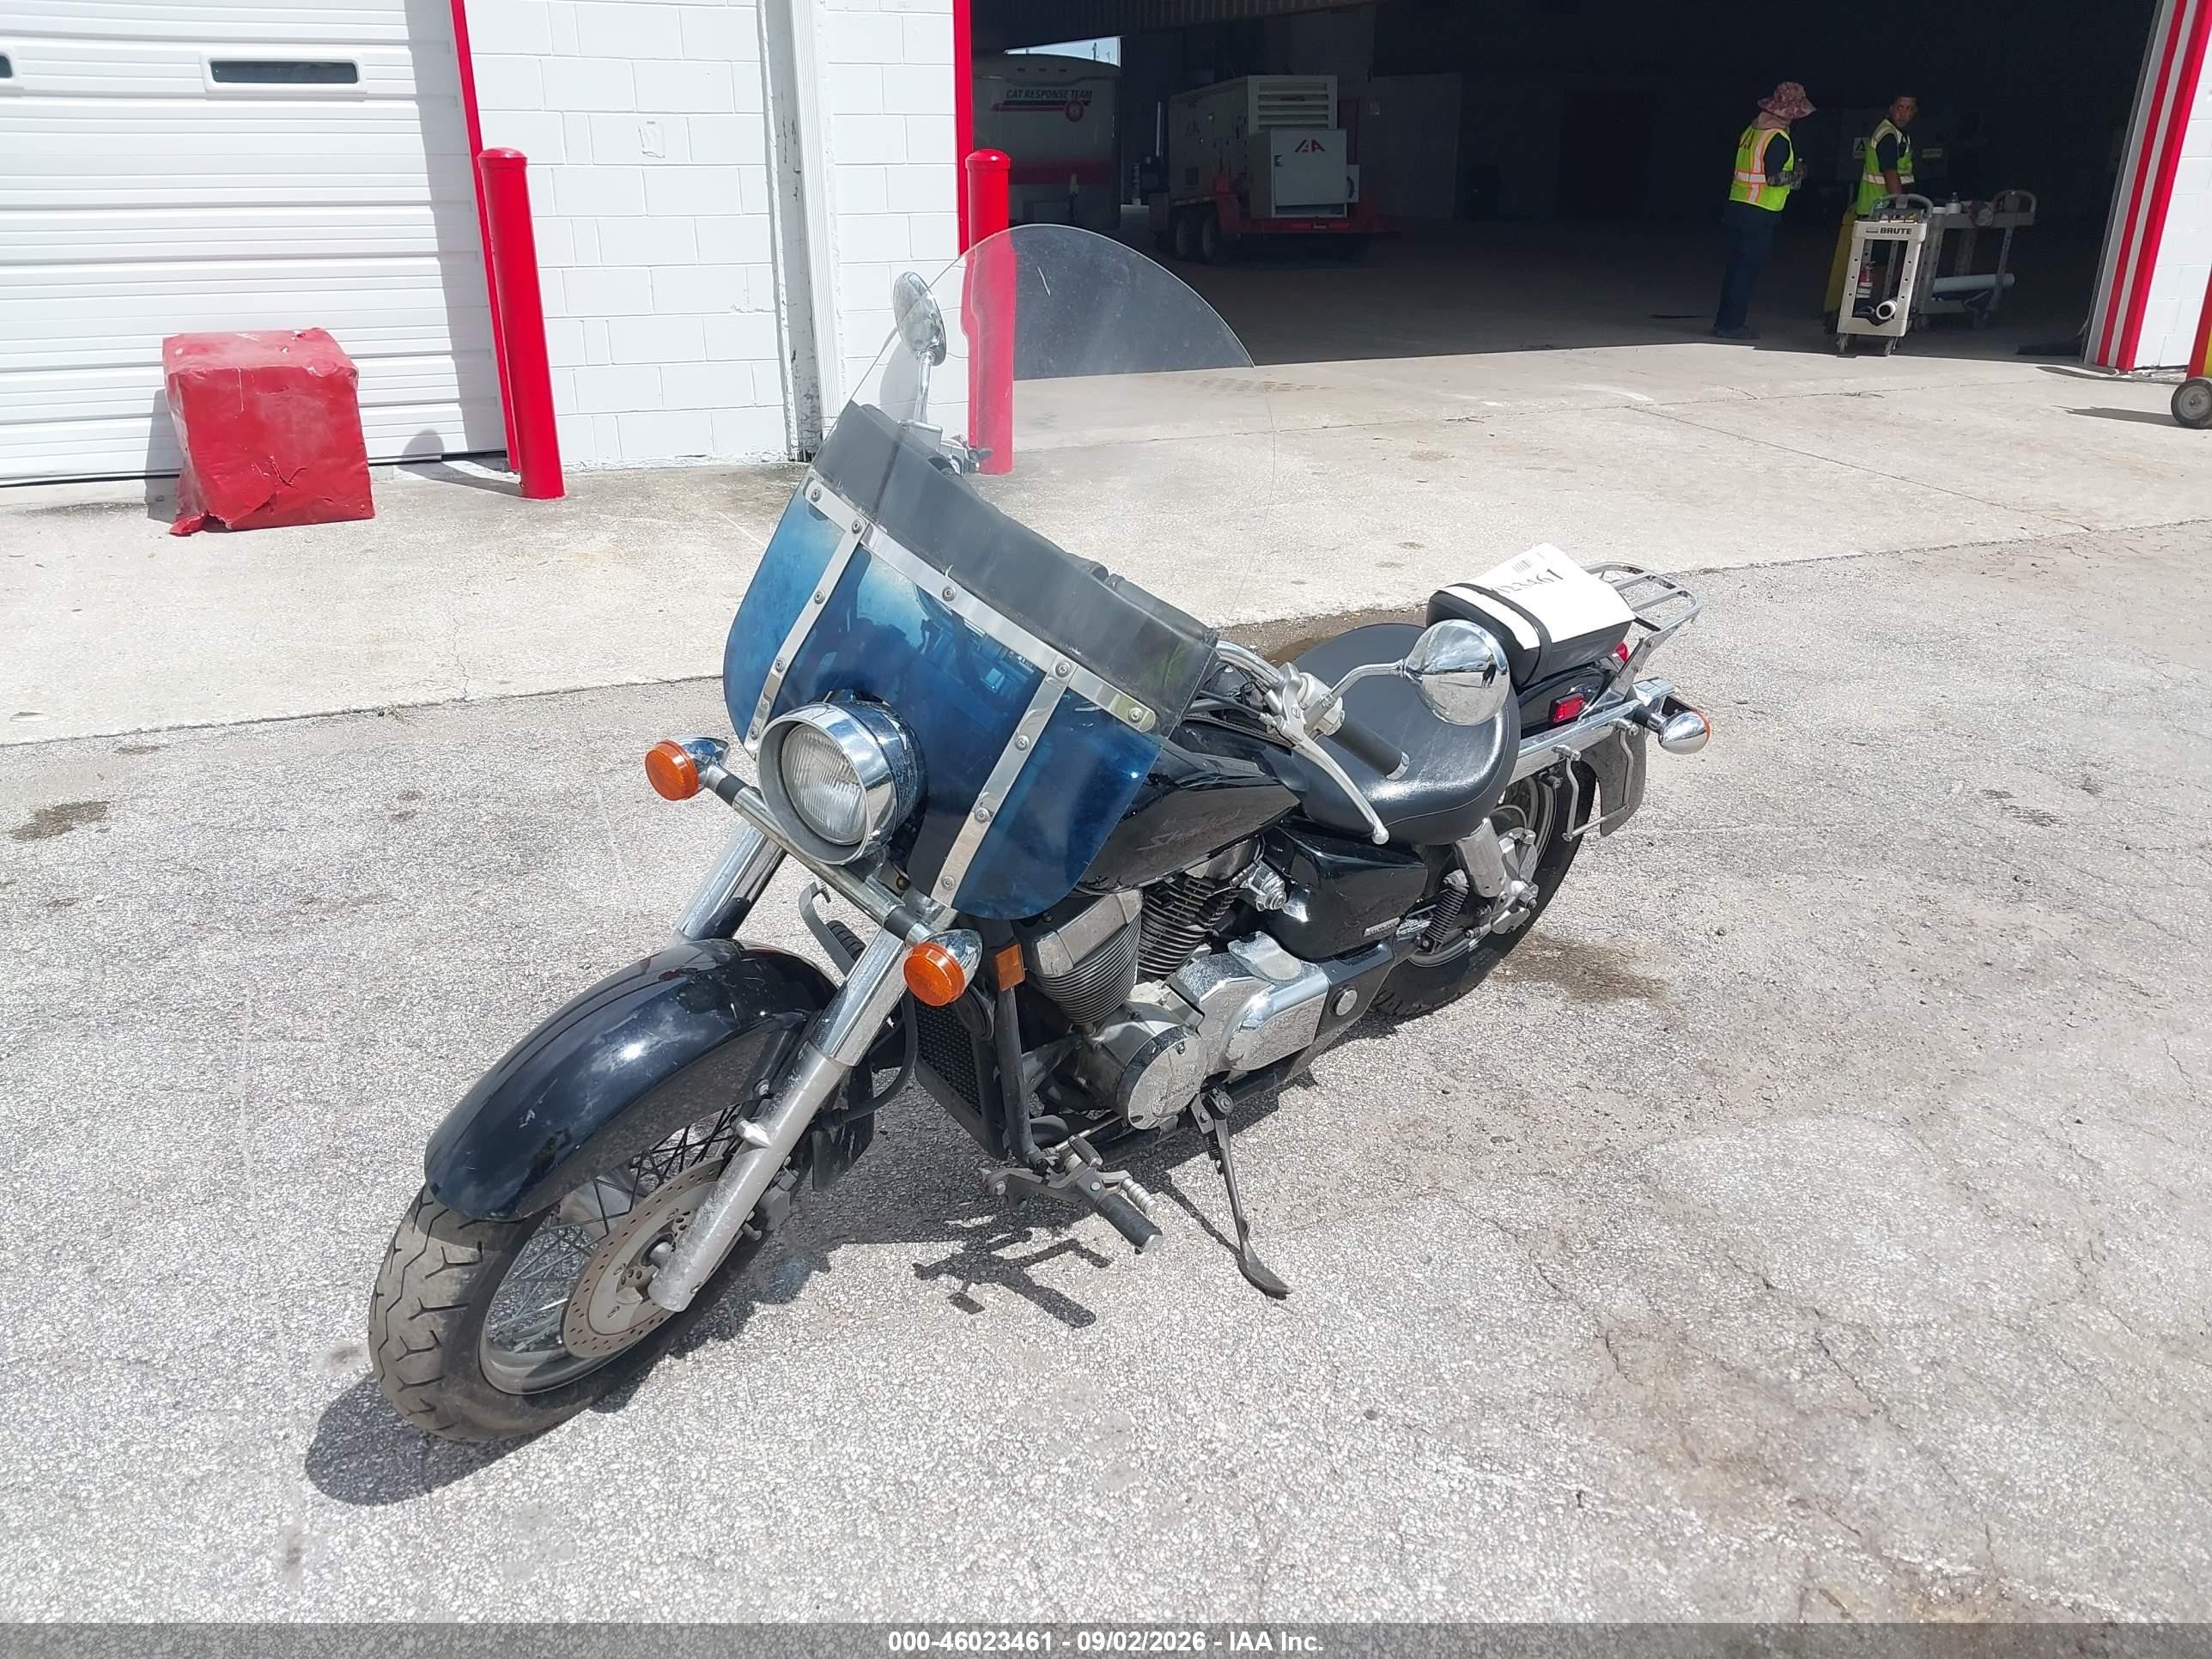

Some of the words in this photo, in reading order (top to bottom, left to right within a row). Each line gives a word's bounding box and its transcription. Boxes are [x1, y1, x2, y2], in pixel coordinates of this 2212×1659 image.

[1006, 89, 1024, 99] CAT
[1024, 89, 1068, 99] RESPONSE
[1071, 89, 1093, 100] TEAM
[1880, 227, 1913, 237] BRUTE
